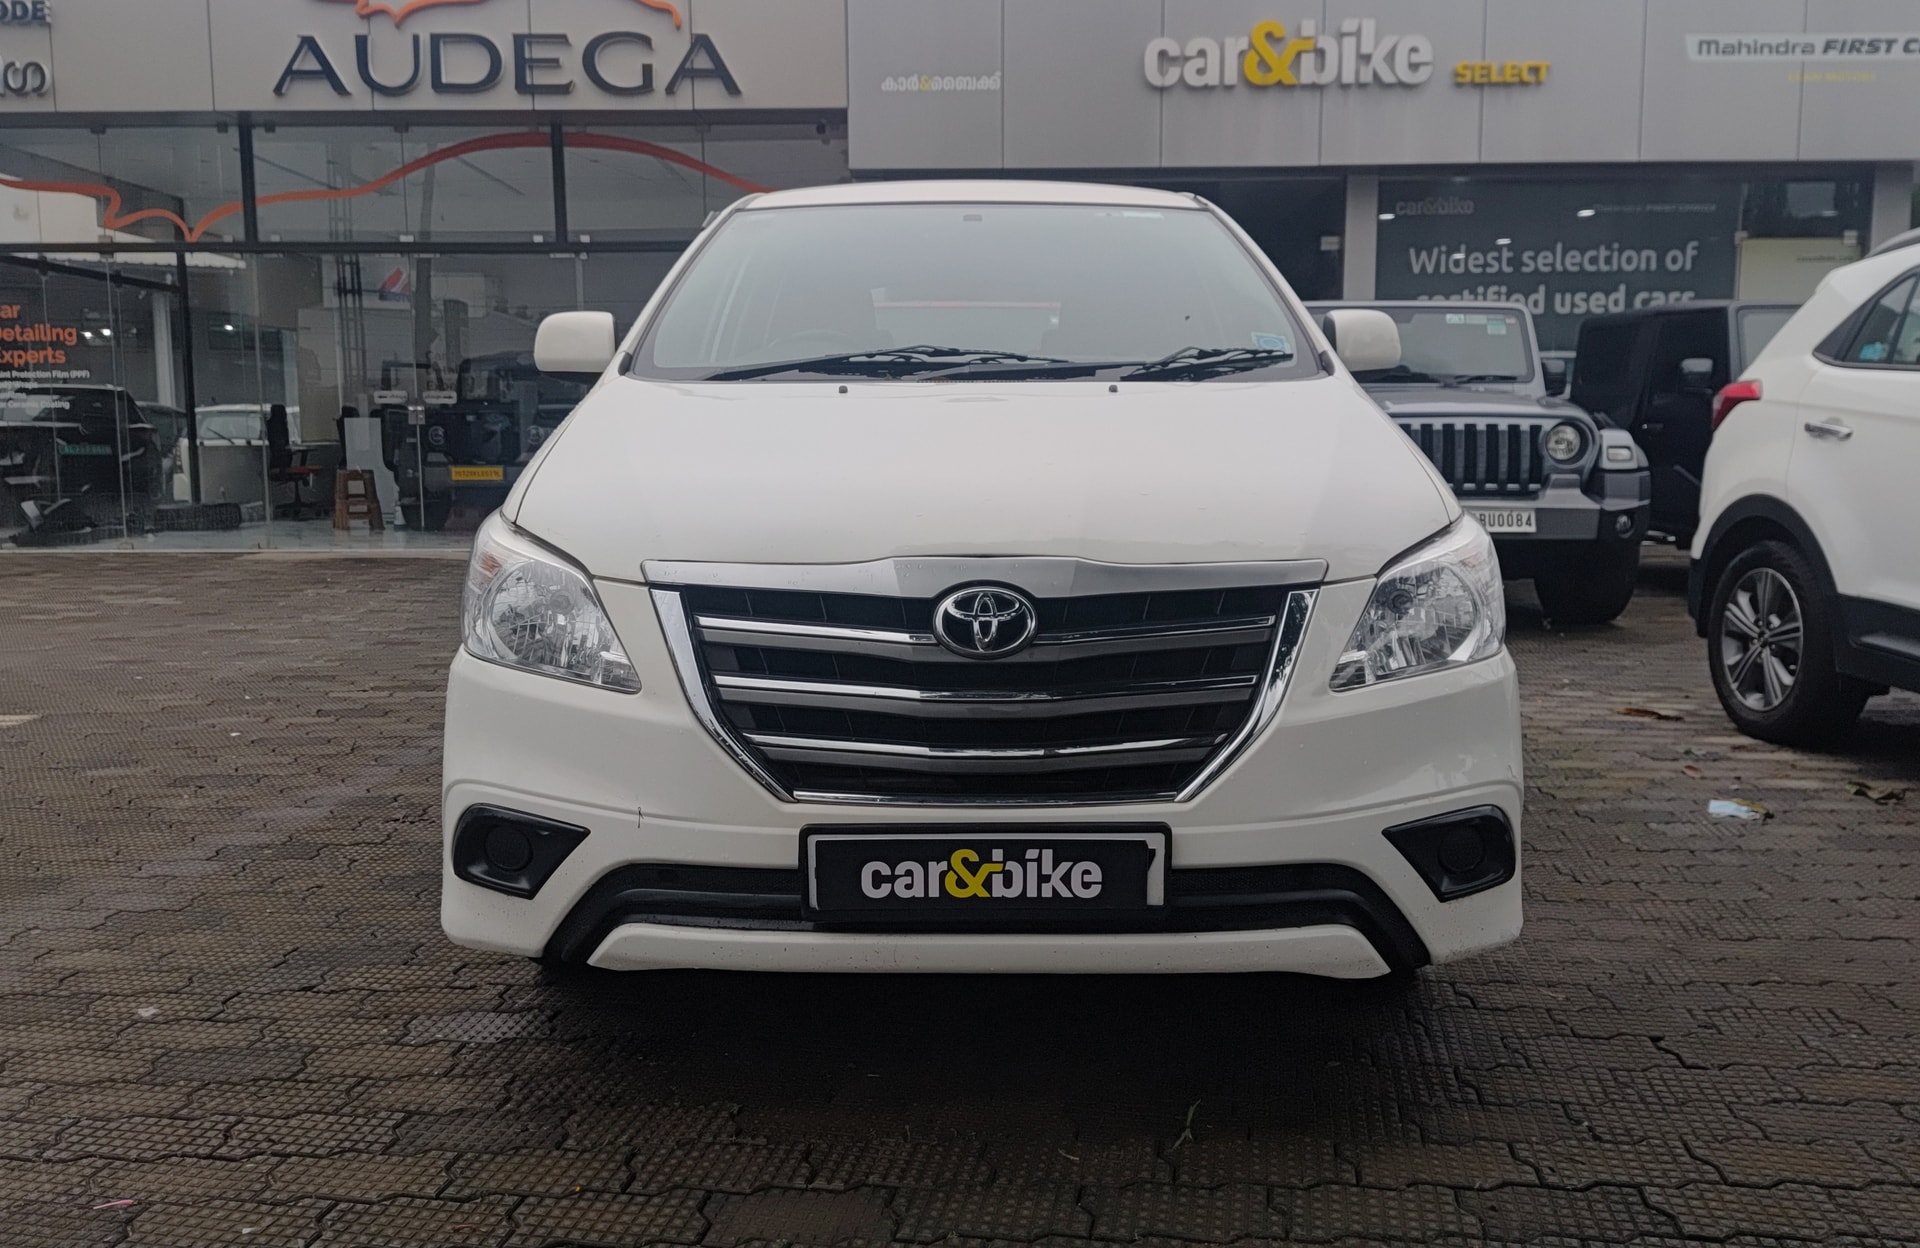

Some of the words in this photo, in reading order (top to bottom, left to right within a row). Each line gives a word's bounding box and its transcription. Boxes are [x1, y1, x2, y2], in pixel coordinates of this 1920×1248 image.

[1143, 18, 1434, 88] car&bike
[1455, 61, 1551, 85] SELECT
[1698, 38, 1816, 56] Mahindra
[1822, 37, 1898, 55] FIRST
[272, 31, 743, 96] AUDEGA
[1409, 243, 1514, 274] Widest
[1520, 241, 1657, 273] selection
[1664, 240, 1700, 272] of
[1555, 283, 1626, 314] used
[0, 323, 77, 346] etailing
[0, 346, 66, 368] xperts
[861, 849, 1102, 899] car&bike
